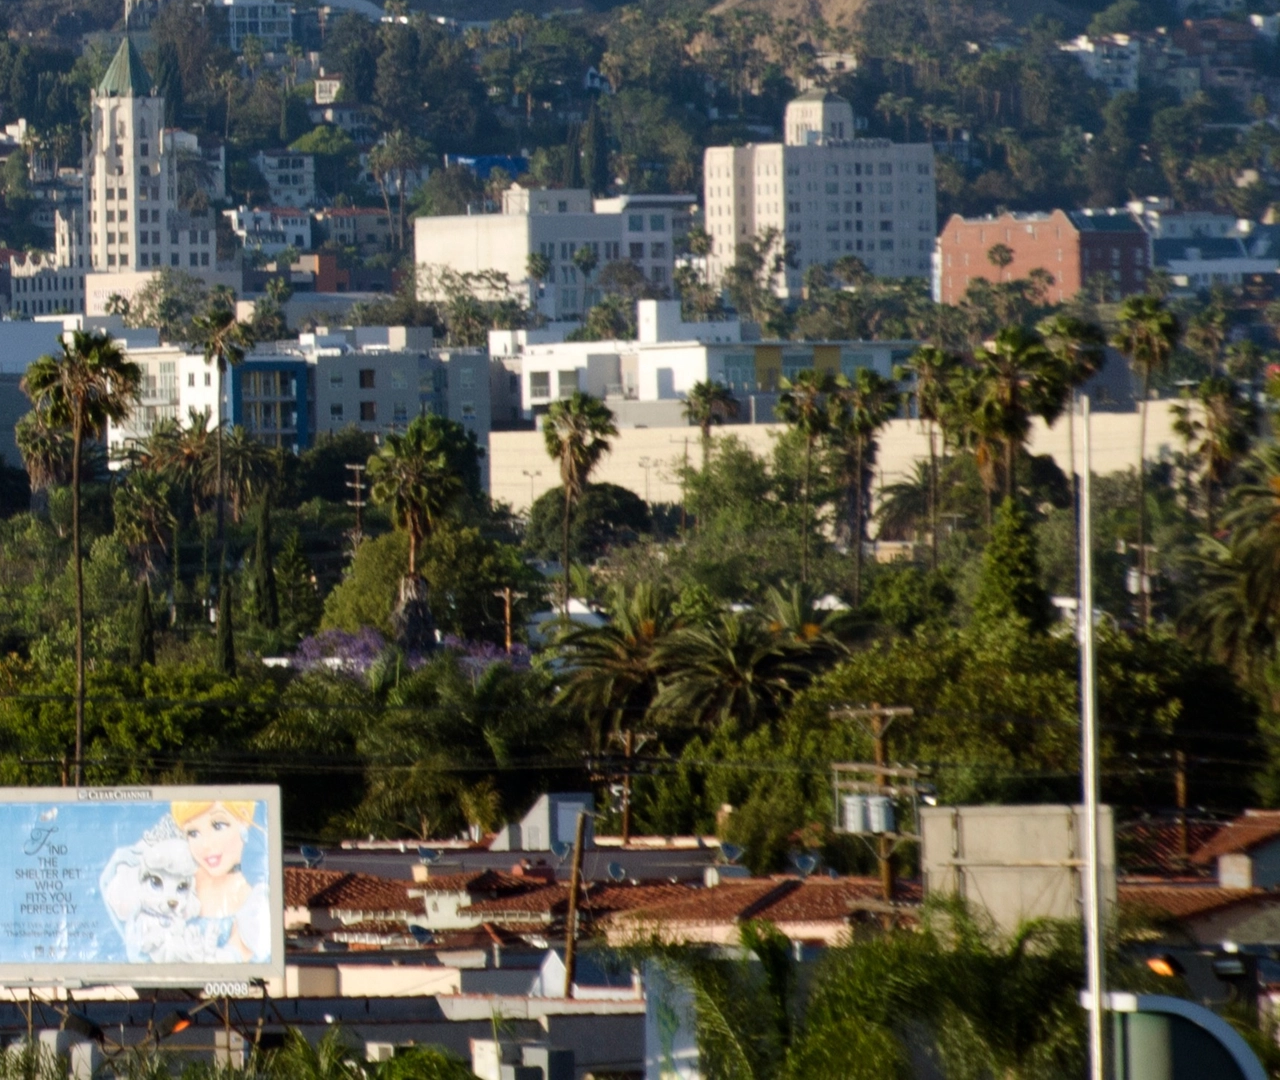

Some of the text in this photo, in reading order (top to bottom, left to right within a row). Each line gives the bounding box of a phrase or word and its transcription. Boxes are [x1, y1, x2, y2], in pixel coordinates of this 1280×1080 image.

[23, 826, 68, 856] FIND
[38, 857, 58, 868] THE
[15, 868, 81, 879] SHELTER PET
[35, 881, 64, 891] WHO
[26, 892, 72, 903] FITS YOU
[20, 904, 77, 915] PERFECTLY
[204, 982, 249, 996] 000098
